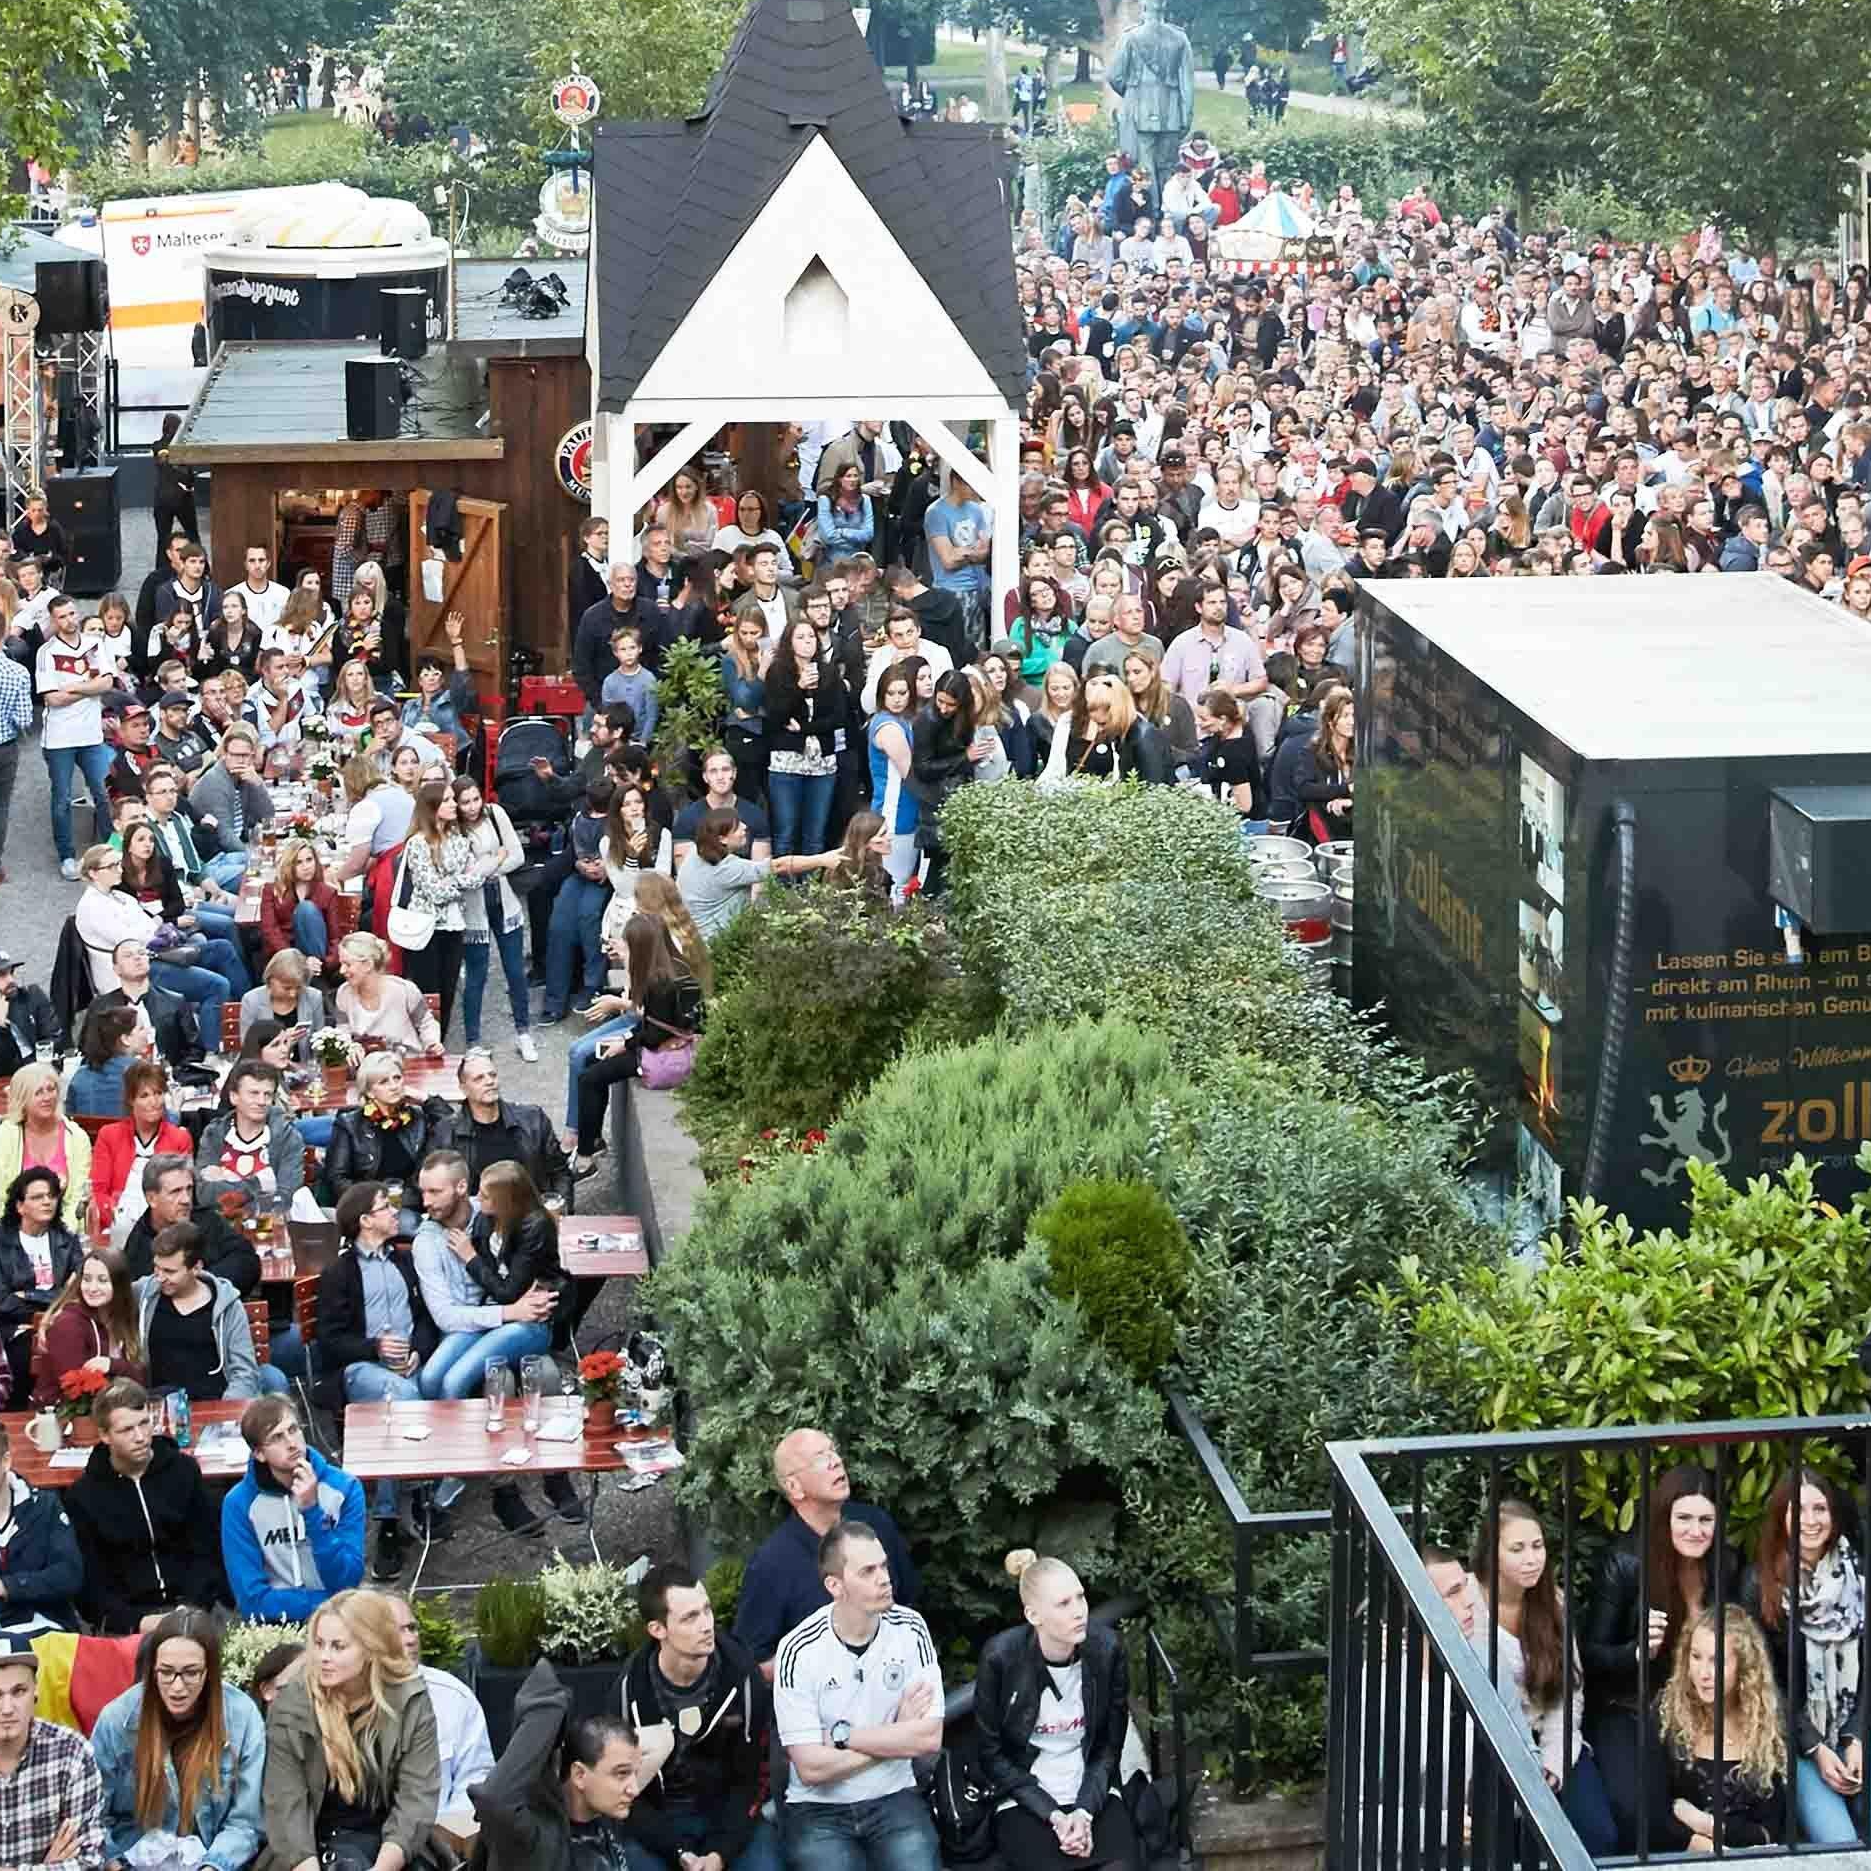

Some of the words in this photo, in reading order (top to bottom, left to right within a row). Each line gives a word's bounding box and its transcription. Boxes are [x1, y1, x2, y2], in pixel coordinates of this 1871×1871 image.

[1657, 952, 1727, 971] Lassen
[1734, 948, 1766, 968] Sie
[1819, 949, 1850, 964] am
[1651, 977, 1711, 996] direkt
[1717, 979, 1748, 994] am
[1835, 972, 1858, 988] im
[1644, 1003, 1677, 1022] mit
